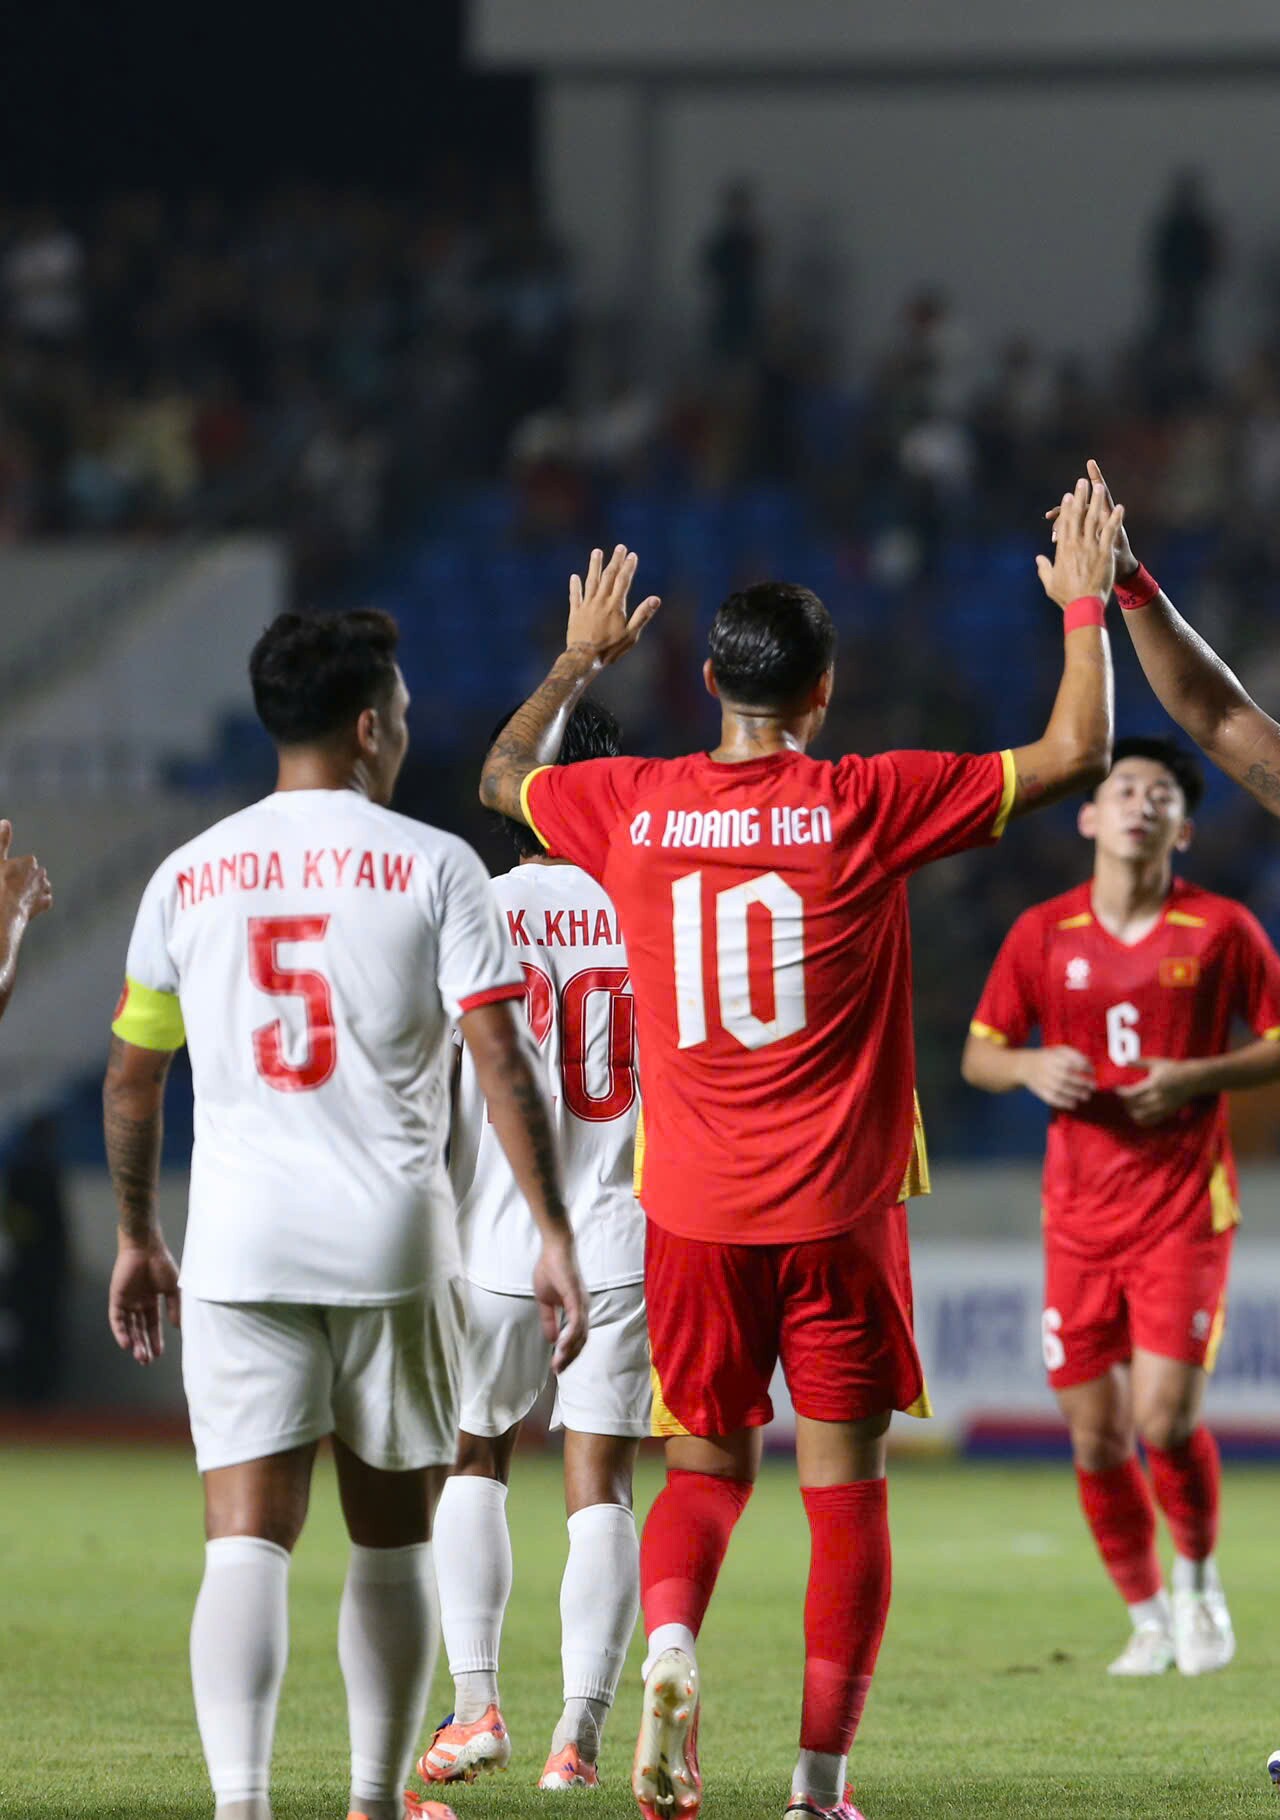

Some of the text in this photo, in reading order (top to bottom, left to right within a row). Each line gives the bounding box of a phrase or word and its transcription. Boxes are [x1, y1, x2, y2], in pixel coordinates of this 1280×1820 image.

[661, 807, 760, 848] HOANG
[771, 804, 833, 846] HEN
[176, 849, 414, 911] NANDA KYAW
[506, 909, 622, 947] K.KHA
[671, 870, 808, 1051] 10
[247, 913, 337, 1093] 5
[1106, 1001, 1141, 1068] 6
[1041, 1306, 1067, 1371] 6
